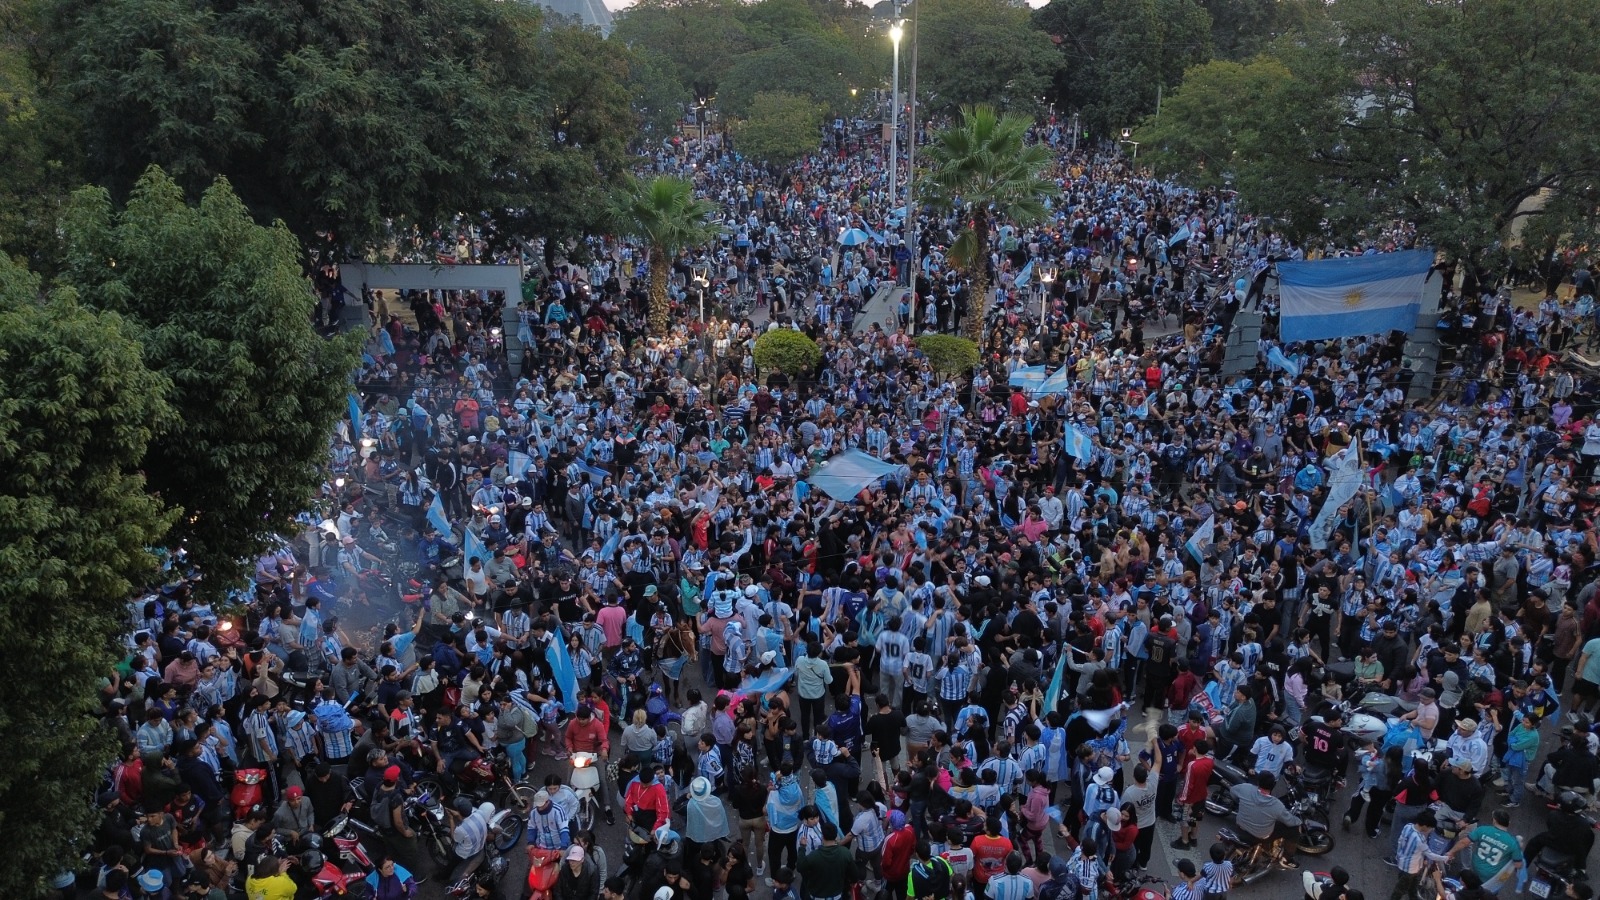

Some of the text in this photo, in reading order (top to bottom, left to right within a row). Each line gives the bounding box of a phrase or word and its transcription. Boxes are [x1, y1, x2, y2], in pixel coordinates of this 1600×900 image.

[884, 643, 899, 657] 10
[1151, 646, 1164, 663] 10
[1247, 653, 1257, 669] 10
[909, 662, 924, 679] 10
[1313, 736, 1329, 752] 10
[1266, 753, 1275, 762] 10
[1478, 842, 1502, 867] 23
